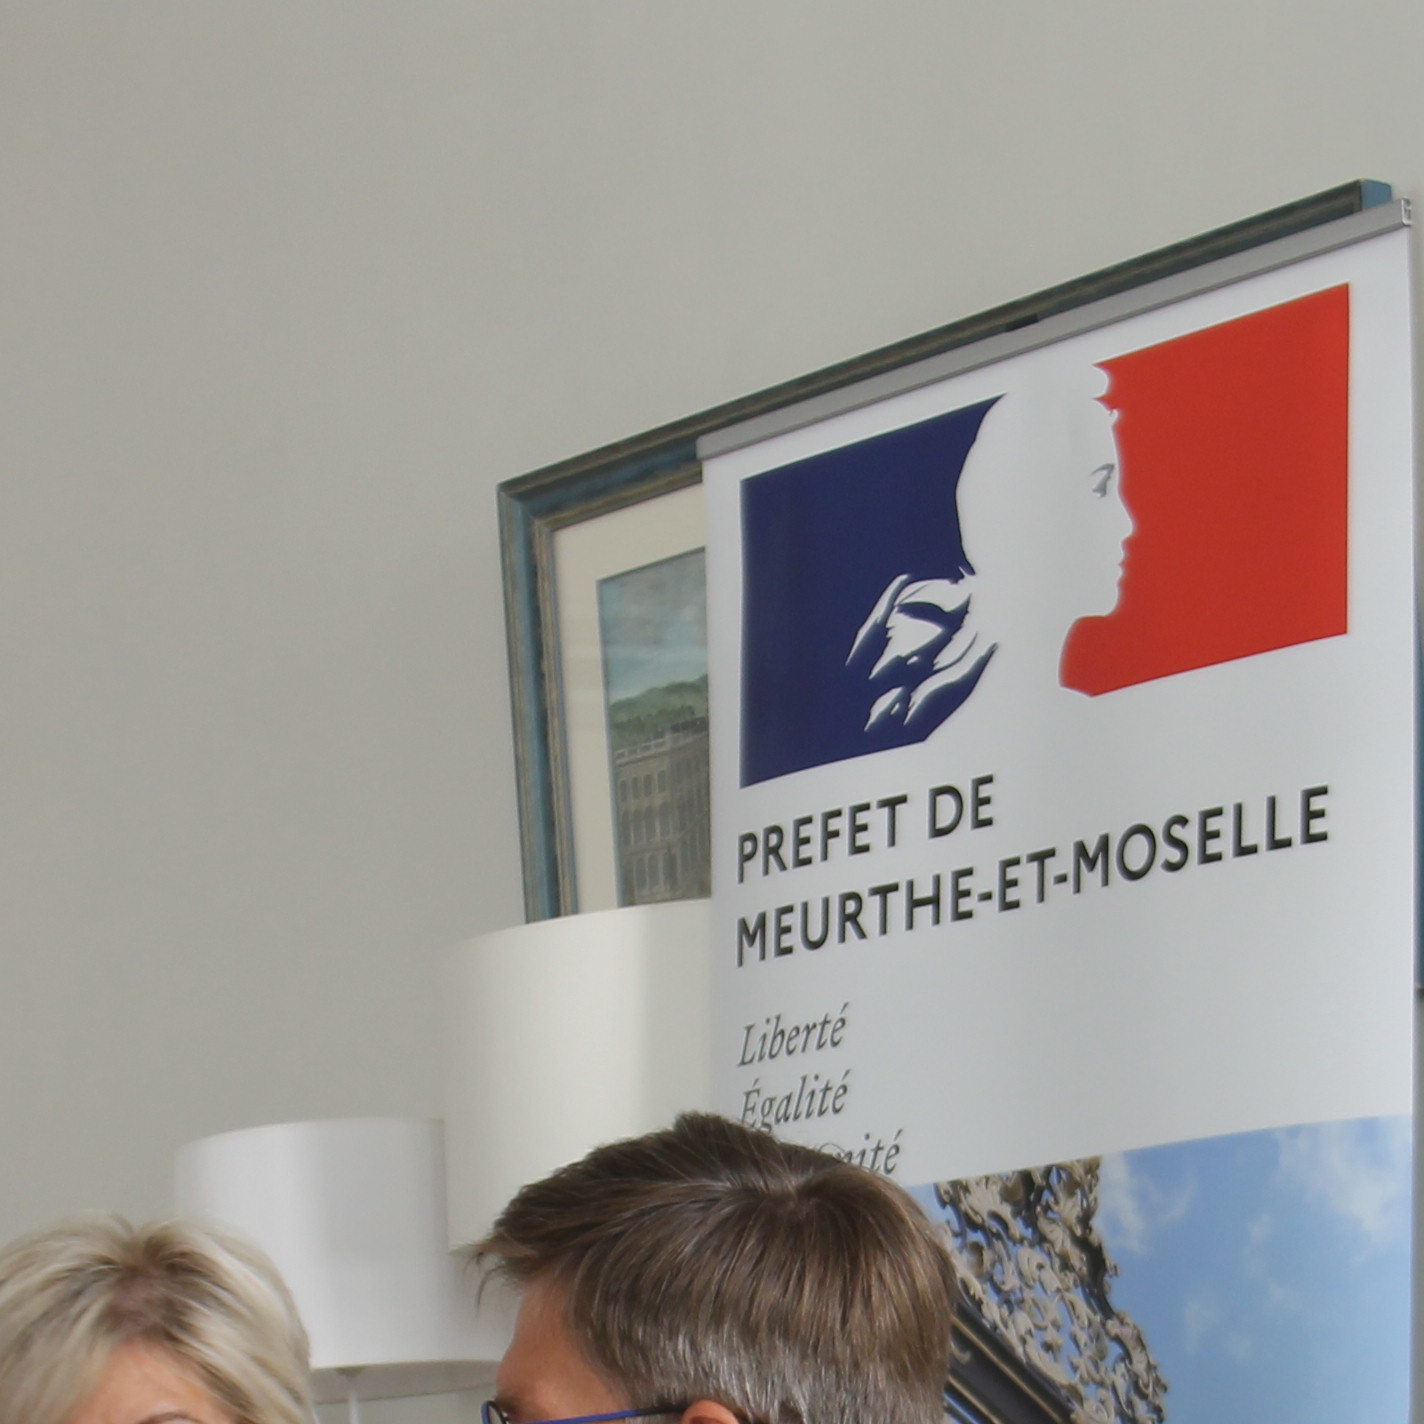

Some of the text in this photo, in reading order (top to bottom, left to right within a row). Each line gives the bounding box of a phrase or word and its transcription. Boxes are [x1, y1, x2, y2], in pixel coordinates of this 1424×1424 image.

[737, 774, 995, 883] PREFET DE
[736, 785, 1329, 967] MEURTHE-ET-MOSELLE
[737, 1002, 849, 1067] Liberté
[739, 1069, 851, 1133] Égalité
